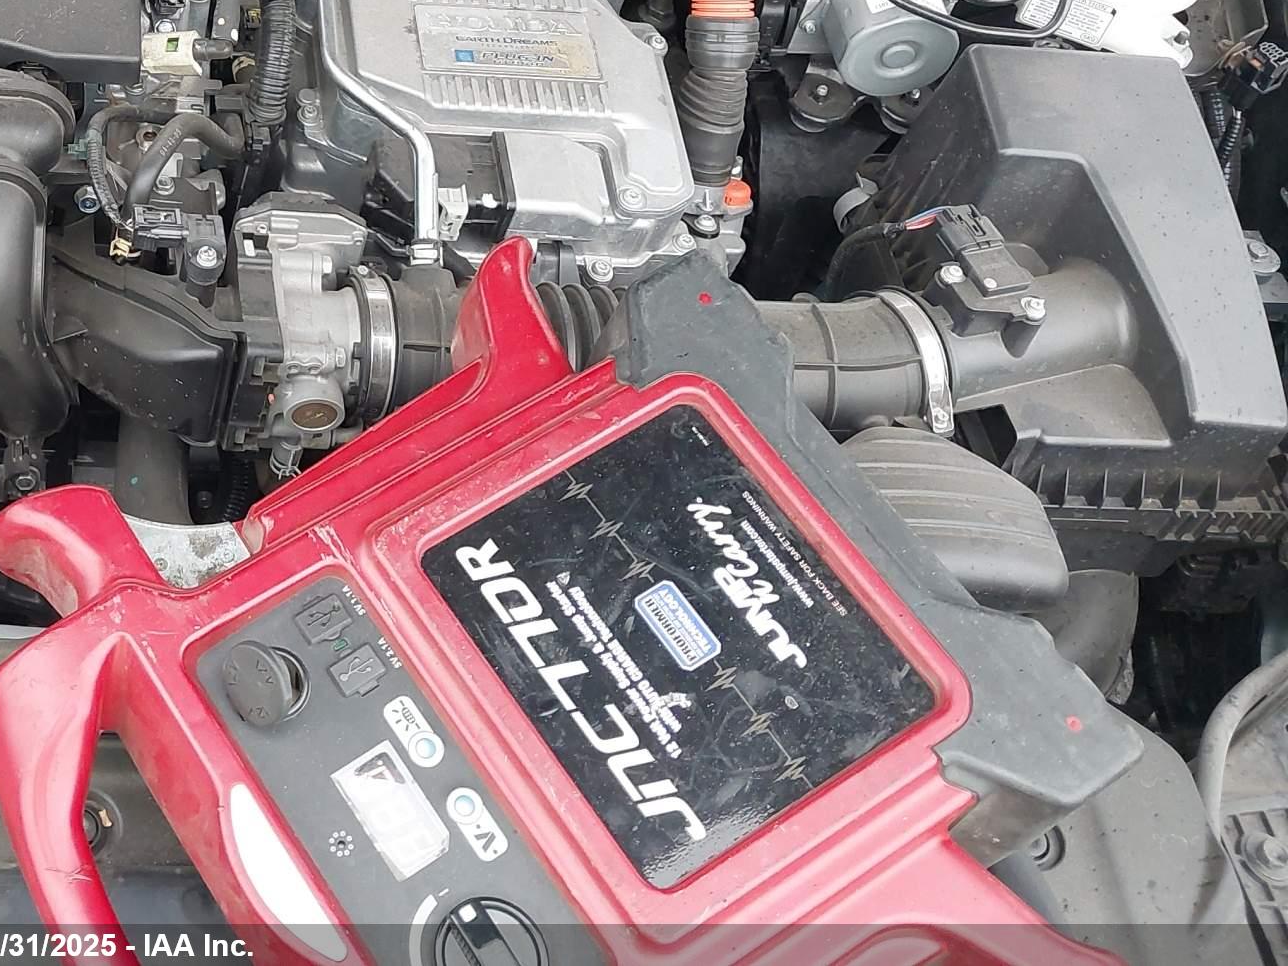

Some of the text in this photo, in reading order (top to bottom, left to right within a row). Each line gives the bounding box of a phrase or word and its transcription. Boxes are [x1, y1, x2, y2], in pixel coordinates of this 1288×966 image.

[481, 52, 554, 62] PLUG-IN
[506, 36, 558, 46] DREAMS
[740, 520, 813, 607] www.jumpstarter.com
[742, 491, 847, 616] SEE BACK FOR SAFETY WARNINGS
[545, 581, 575, 616] Starter
[568, 586, 612, 642] Technology
[713, 563, 806, 667] JUMP
[571, 614, 597, 645] Jump
[642, 597, 697, 663] PROFORMER
[377, 636, 402, 668] 5V 2.1A
[591, 641, 604, 654] &
[606, 639, 642, 681] CHARGE
[599, 652, 630, 688] Supply
[625, 687, 657, 722] Power
[649, 717, 670, 744] Volt
